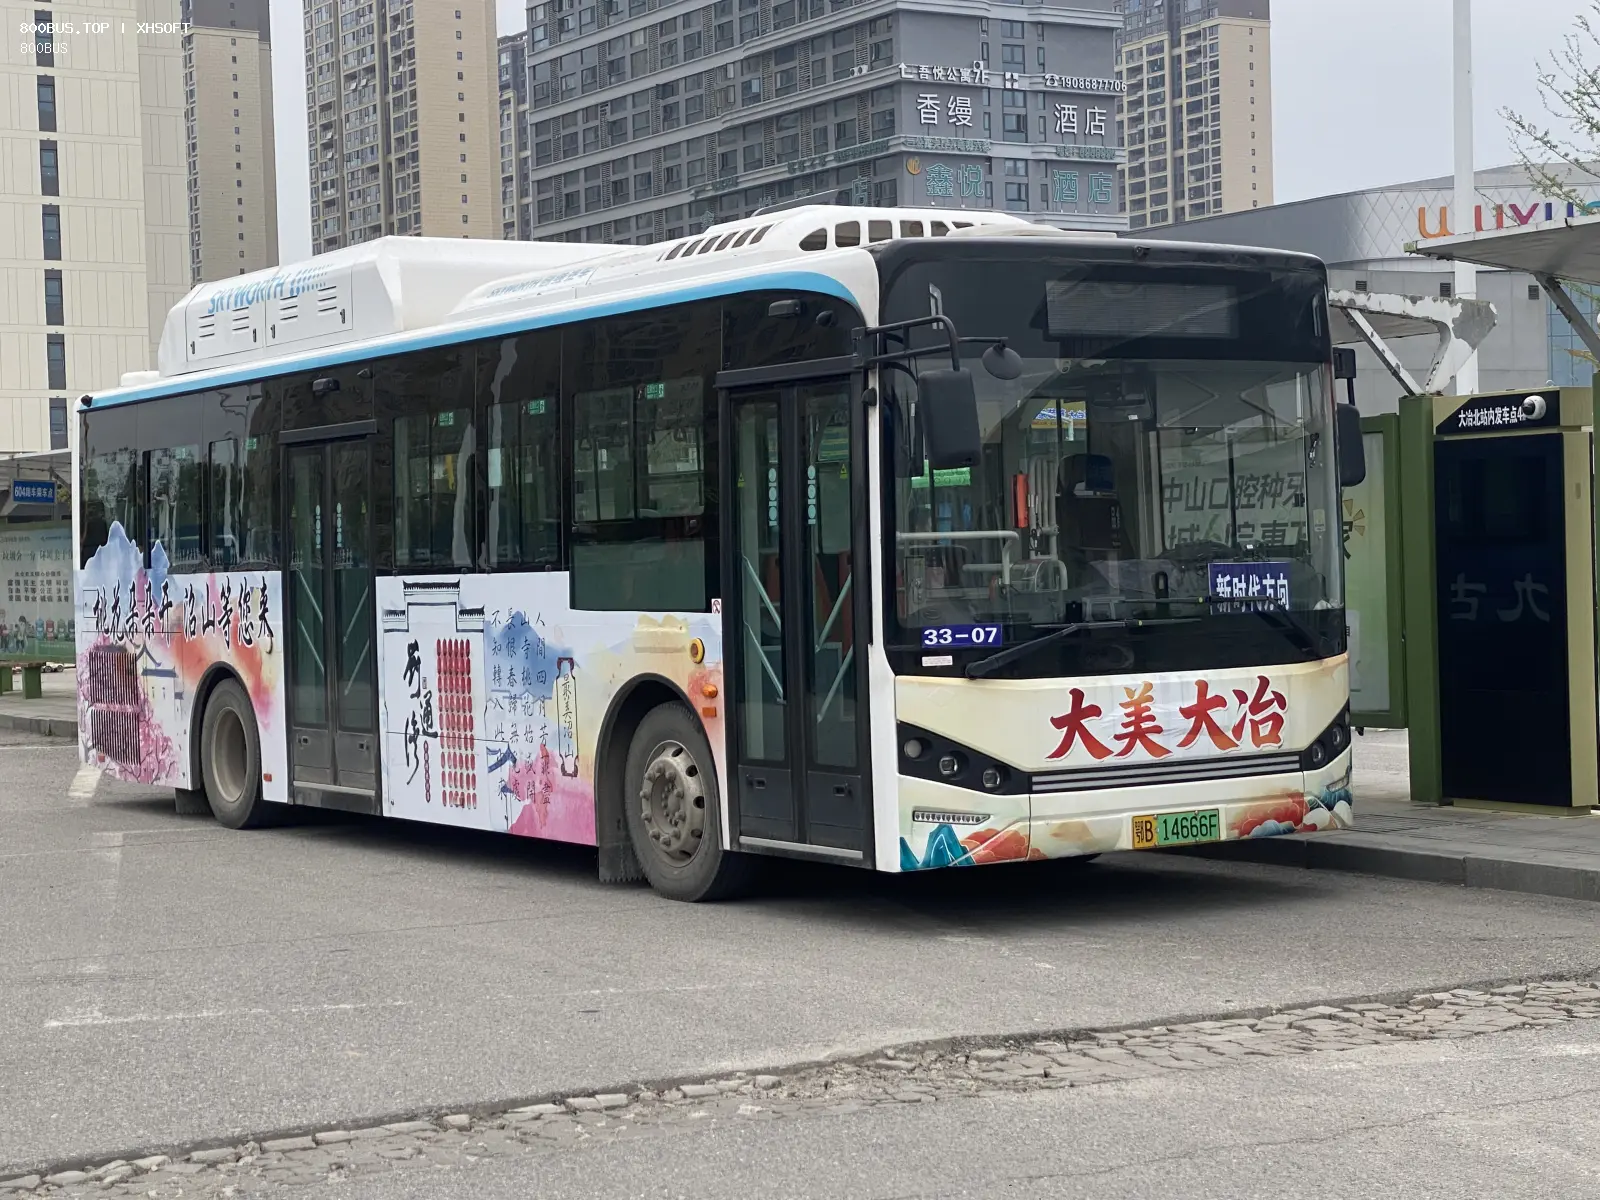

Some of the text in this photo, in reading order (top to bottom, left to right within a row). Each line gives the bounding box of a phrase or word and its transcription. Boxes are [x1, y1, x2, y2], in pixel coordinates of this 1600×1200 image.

[1053, 103, 1107, 136] 酒店
[926, 163, 1113, 204] 鑫悦 酒店
[1215, 572, 1290, 613] 新时代方向
[923, 627, 998, 646] 33-07
[1044, 674, 1289, 760] 大美大冶
[1134, 813, 1218, 844] 鄂B 14666F
